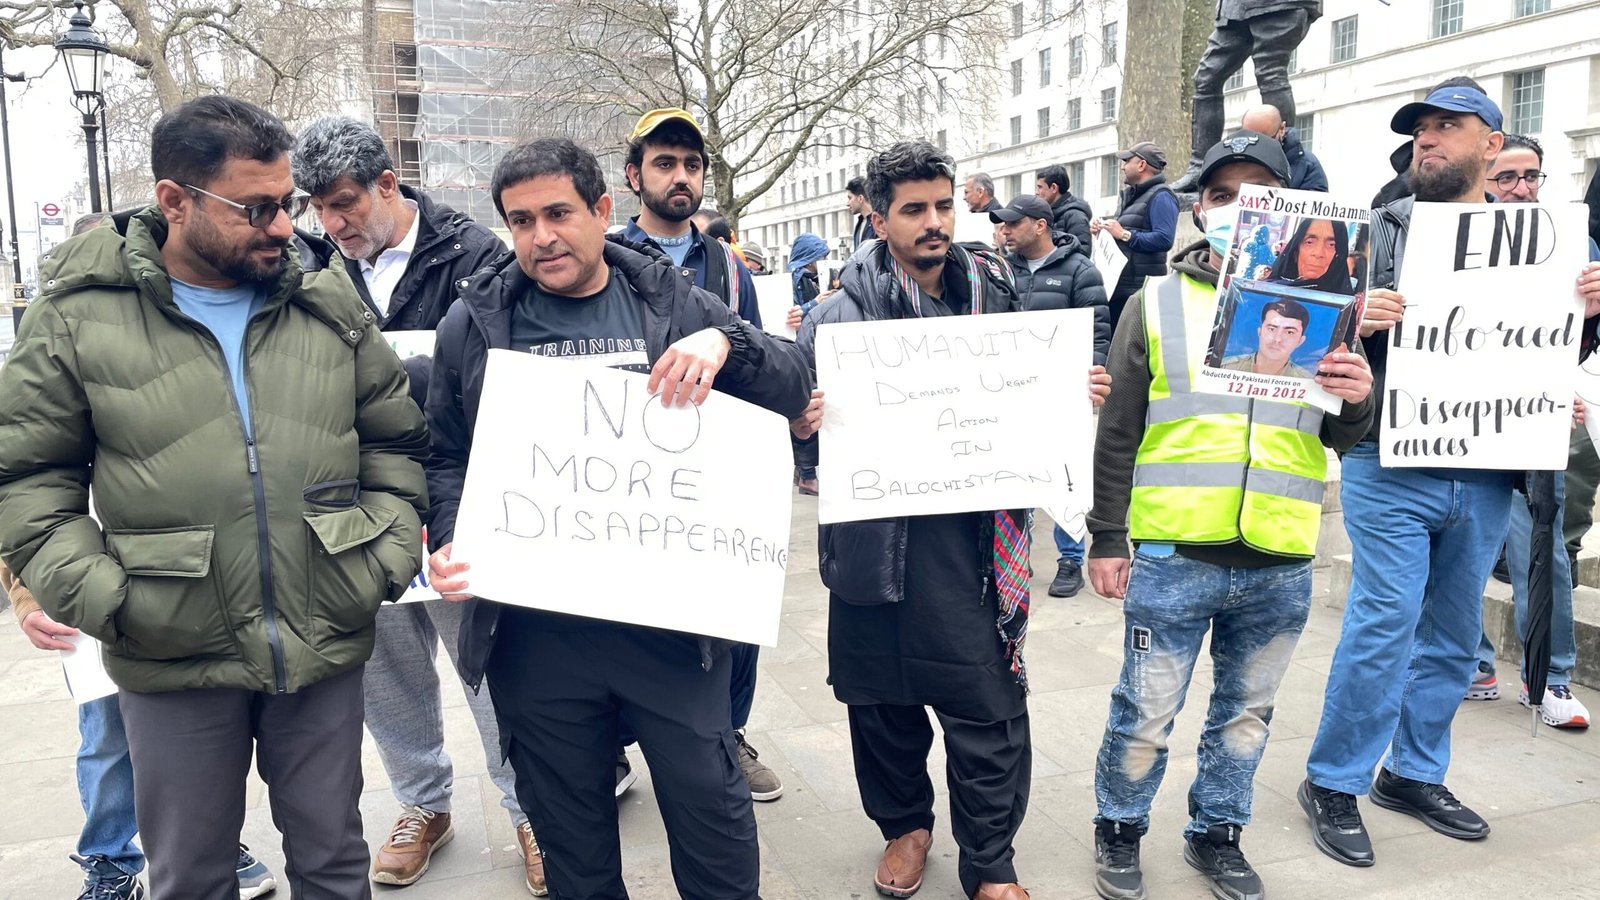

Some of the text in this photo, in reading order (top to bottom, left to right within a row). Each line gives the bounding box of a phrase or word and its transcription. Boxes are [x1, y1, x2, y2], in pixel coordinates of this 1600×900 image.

[1238, 194, 1271, 211] SAVE
[1274, 196, 1307, 214] Dost
[1453, 207, 1556, 272] END
[1393, 304, 1575, 357] Enforced
[529, 338, 648, 357] TRAINING
[832, 325, 1059, 370] HUMANITY
[1201, 369, 1231, 379] Abducted
[1232, 373, 1241, 381] by
[1241, 375, 1271, 384] Pakistani
[1271, 378, 1291, 386] Forces
[1227, 382, 1306, 399] 12 Jan 2012
[583, 379, 701, 454] NO
[951, 440, 993, 458] IN
[1393, 436, 1470, 458] ances
[533, 443, 702, 501] MORE
